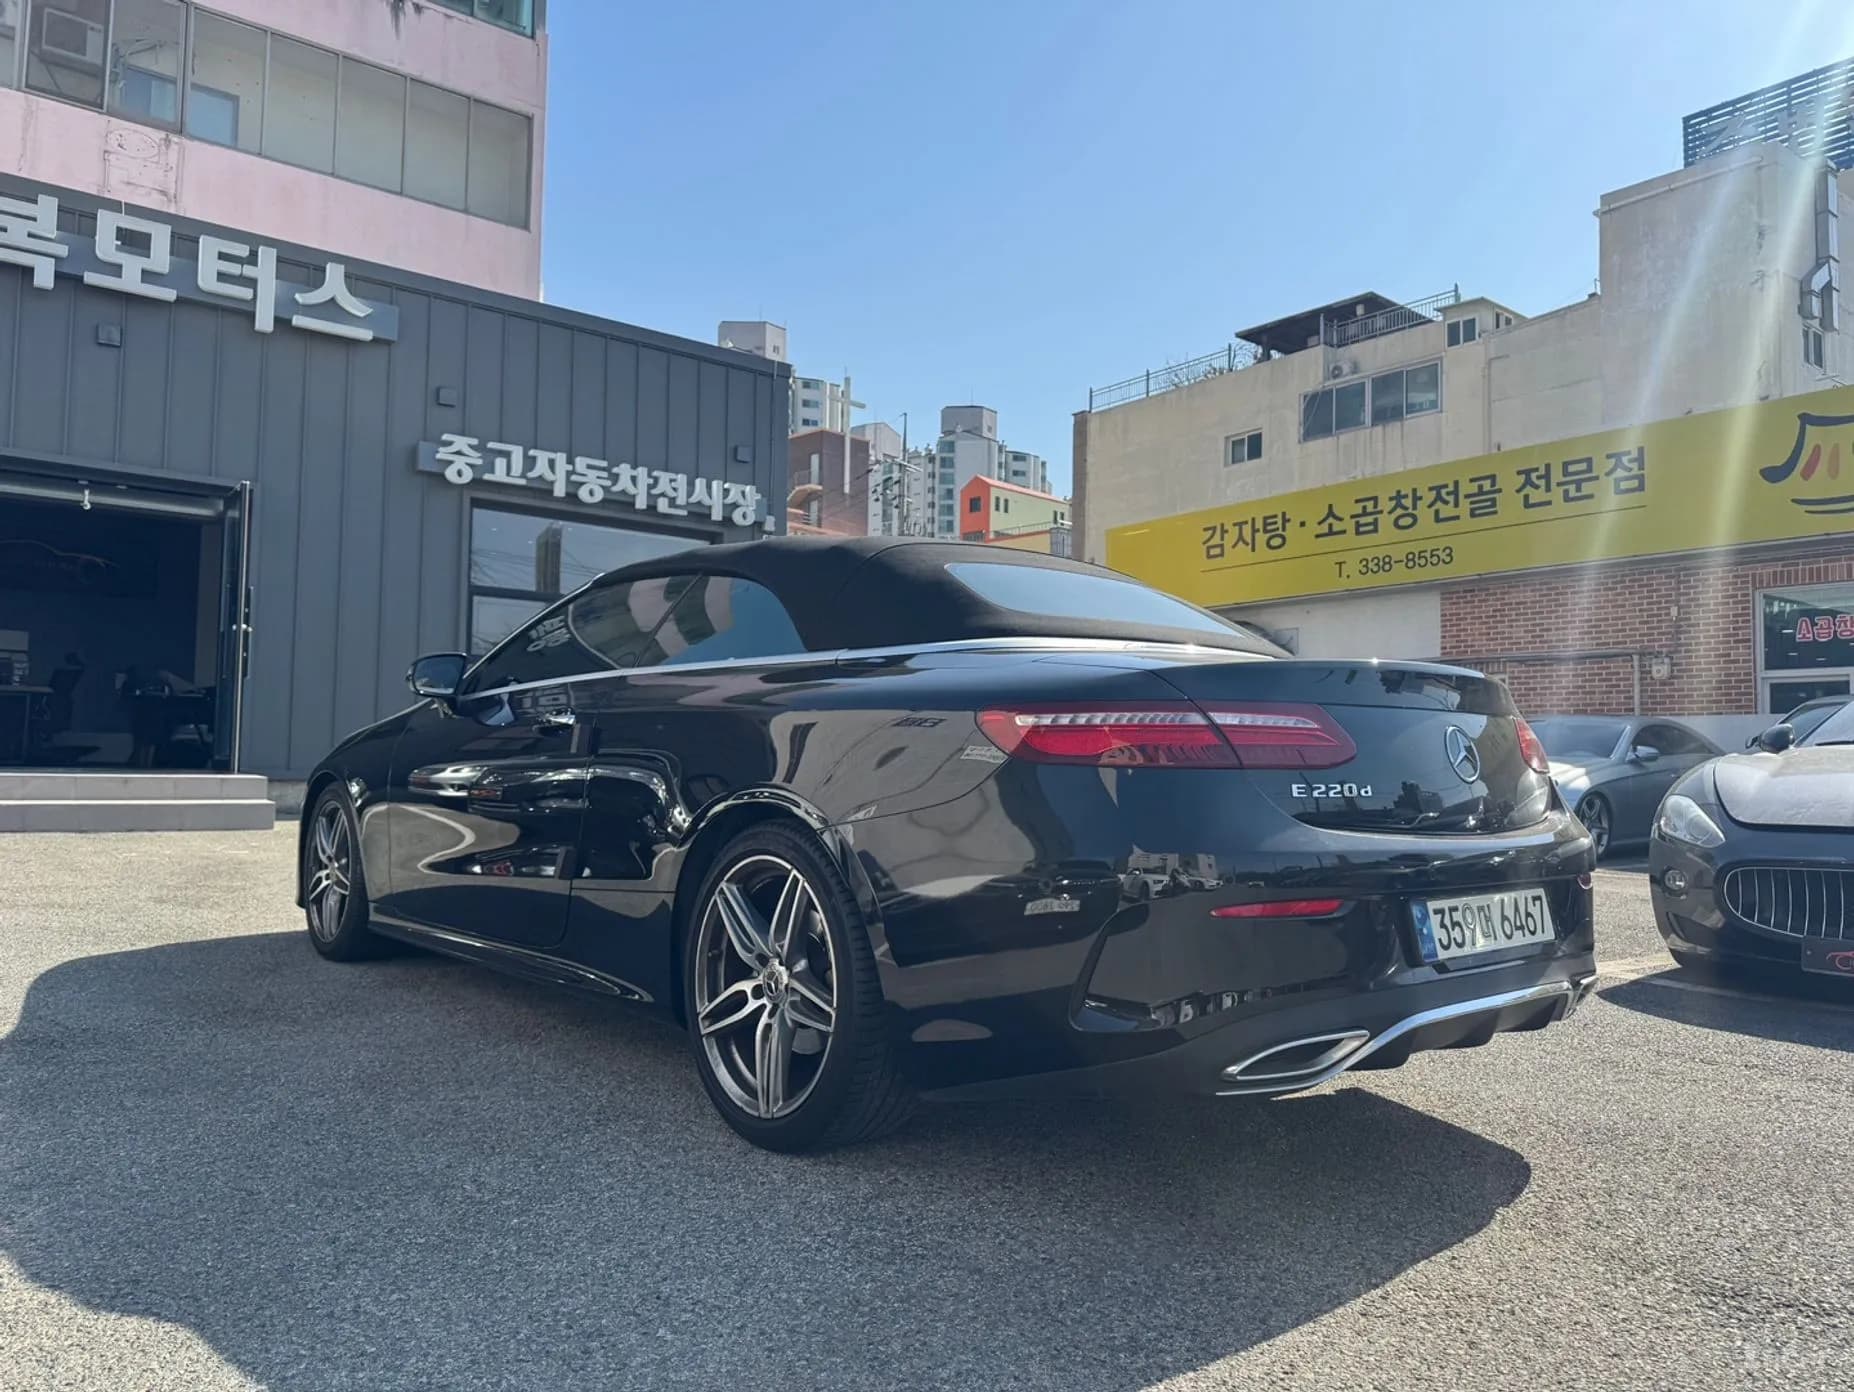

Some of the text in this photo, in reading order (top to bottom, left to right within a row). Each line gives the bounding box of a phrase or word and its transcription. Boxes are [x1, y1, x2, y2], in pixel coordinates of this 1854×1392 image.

[435, 433, 762, 526] 중고자동차전시장
[1515, 445, 1647, 510] 전문점
[1334, 546, 1454, 579] T. 338-8553
[1291, 783, 1308, 798] E
[1500, 894, 1546, 940] 6467
